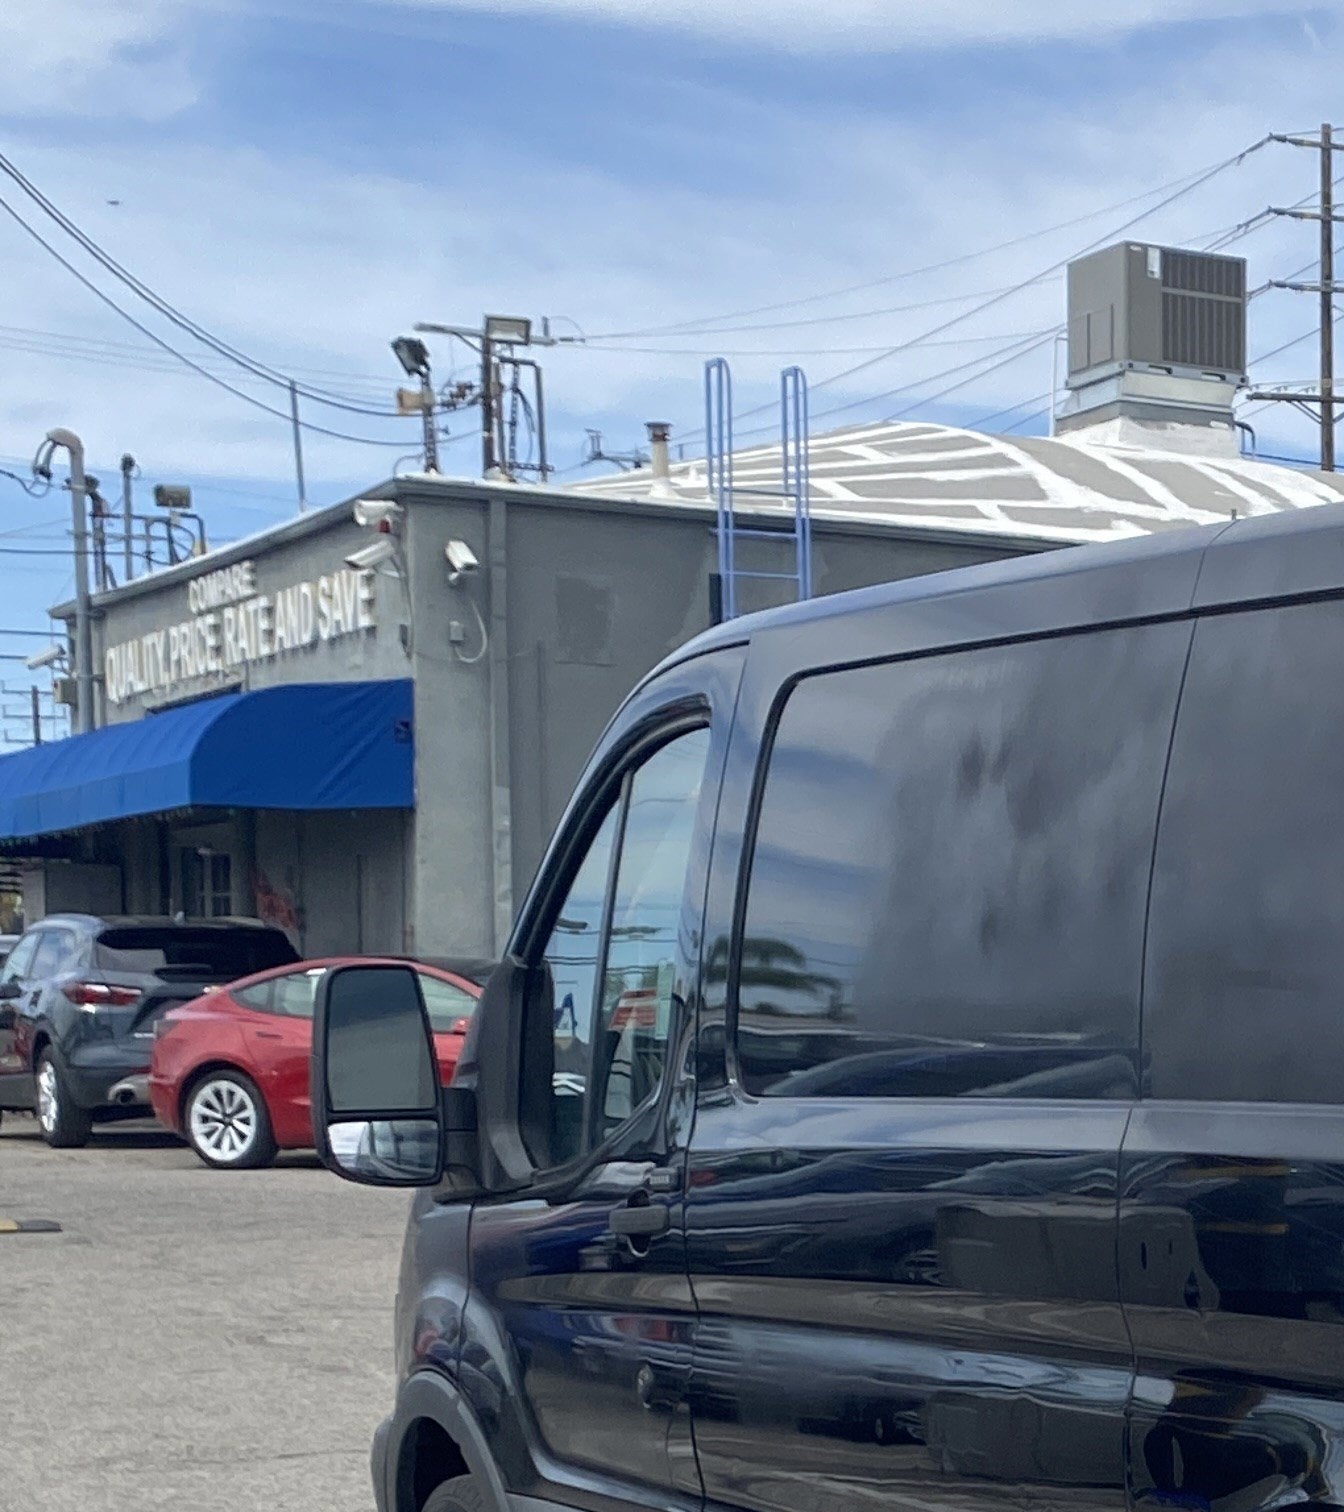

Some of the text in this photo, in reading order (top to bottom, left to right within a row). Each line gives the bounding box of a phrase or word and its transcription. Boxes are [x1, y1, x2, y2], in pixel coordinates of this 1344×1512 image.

[224, 596, 271, 665] RATE
[274, 582, 313, 653] AND
[319, 569, 374, 640] SAVE
